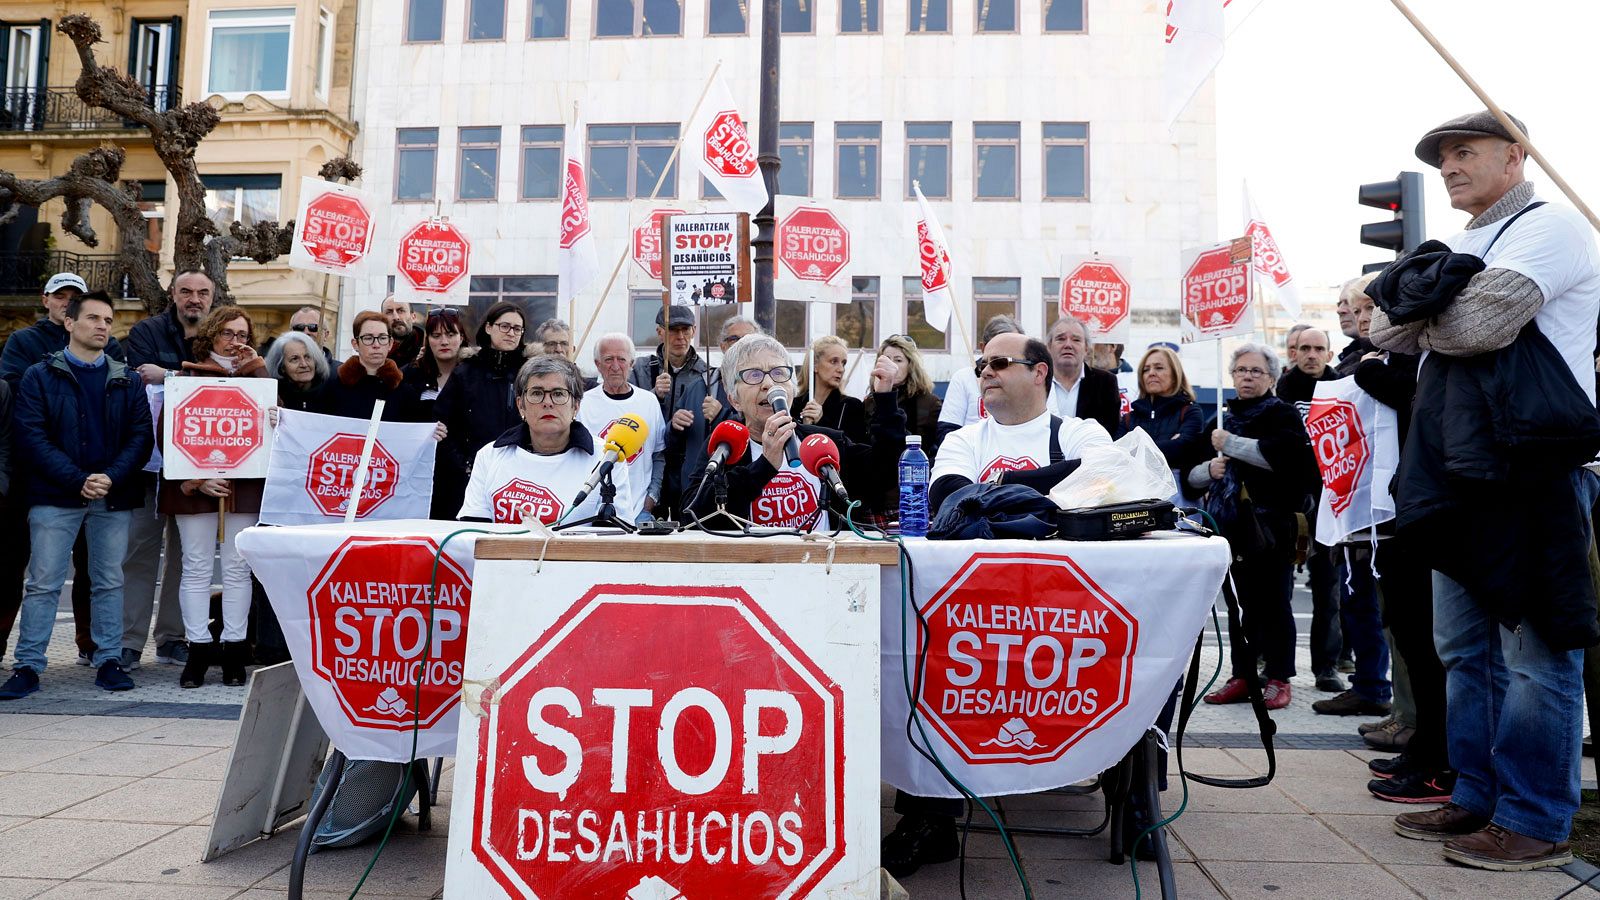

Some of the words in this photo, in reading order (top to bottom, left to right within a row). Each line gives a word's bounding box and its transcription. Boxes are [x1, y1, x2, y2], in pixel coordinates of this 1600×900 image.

[714, 123, 756, 163] STOP
[708, 135, 748, 173] DESAHUCIOS
[310, 208, 366, 226] KALERATZEAK
[307, 216, 365, 241] STOP
[674, 222, 730, 232] KALERATZEAK
[785, 225, 841, 237] KALERATZEAK
[305, 233, 363, 250] DESAHUCIOS
[408, 238, 462, 249] KALERATZEAK
[675, 233, 733, 251] STOP!
[785, 233, 842, 253] STOP
[407, 246, 462, 265] STOP
[674, 253, 731, 263] DESAHUCIOS
[785, 251, 842, 263] DESAHUCIOS
[406, 262, 460, 273] DESAHUCIOS
[1189, 265, 1244, 285] KALERATZEAK
[1070, 279, 1122, 290] KALERATZEAK
[1189, 275, 1245, 303] STOP
[1069, 287, 1123, 306] STOP
[1188, 294, 1245, 313] DESAHUCIOS
[1069, 304, 1121, 315] DESAHUCIOS
[184, 407, 253, 417] KALERATZEAK
[183, 416, 254, 437] STOP
[182, 436, 252, 447] DESAHUCIOS
[317, 484, 383, 499] DESAHCIOS
[502, 490, 553, 505] KALERATZEAK
[496, 498, 553, 521] STOP
[758, 490, 808, 521] STOP
[329, 582, 466, 606] KALERATZEAK
[946, 603, 1110, 634] KALERATZEAK
[334, 606, 462, 659] STOP
[945, 631, 1106, 688] STOP
[334, 656, 463, 686] DESAHUCIOS
[941, 688, 1098, 717] DESAHUCIOS
[522, 687, 804, 799] STOP
[516, 808, 804, 867] DESAHUCIOS
